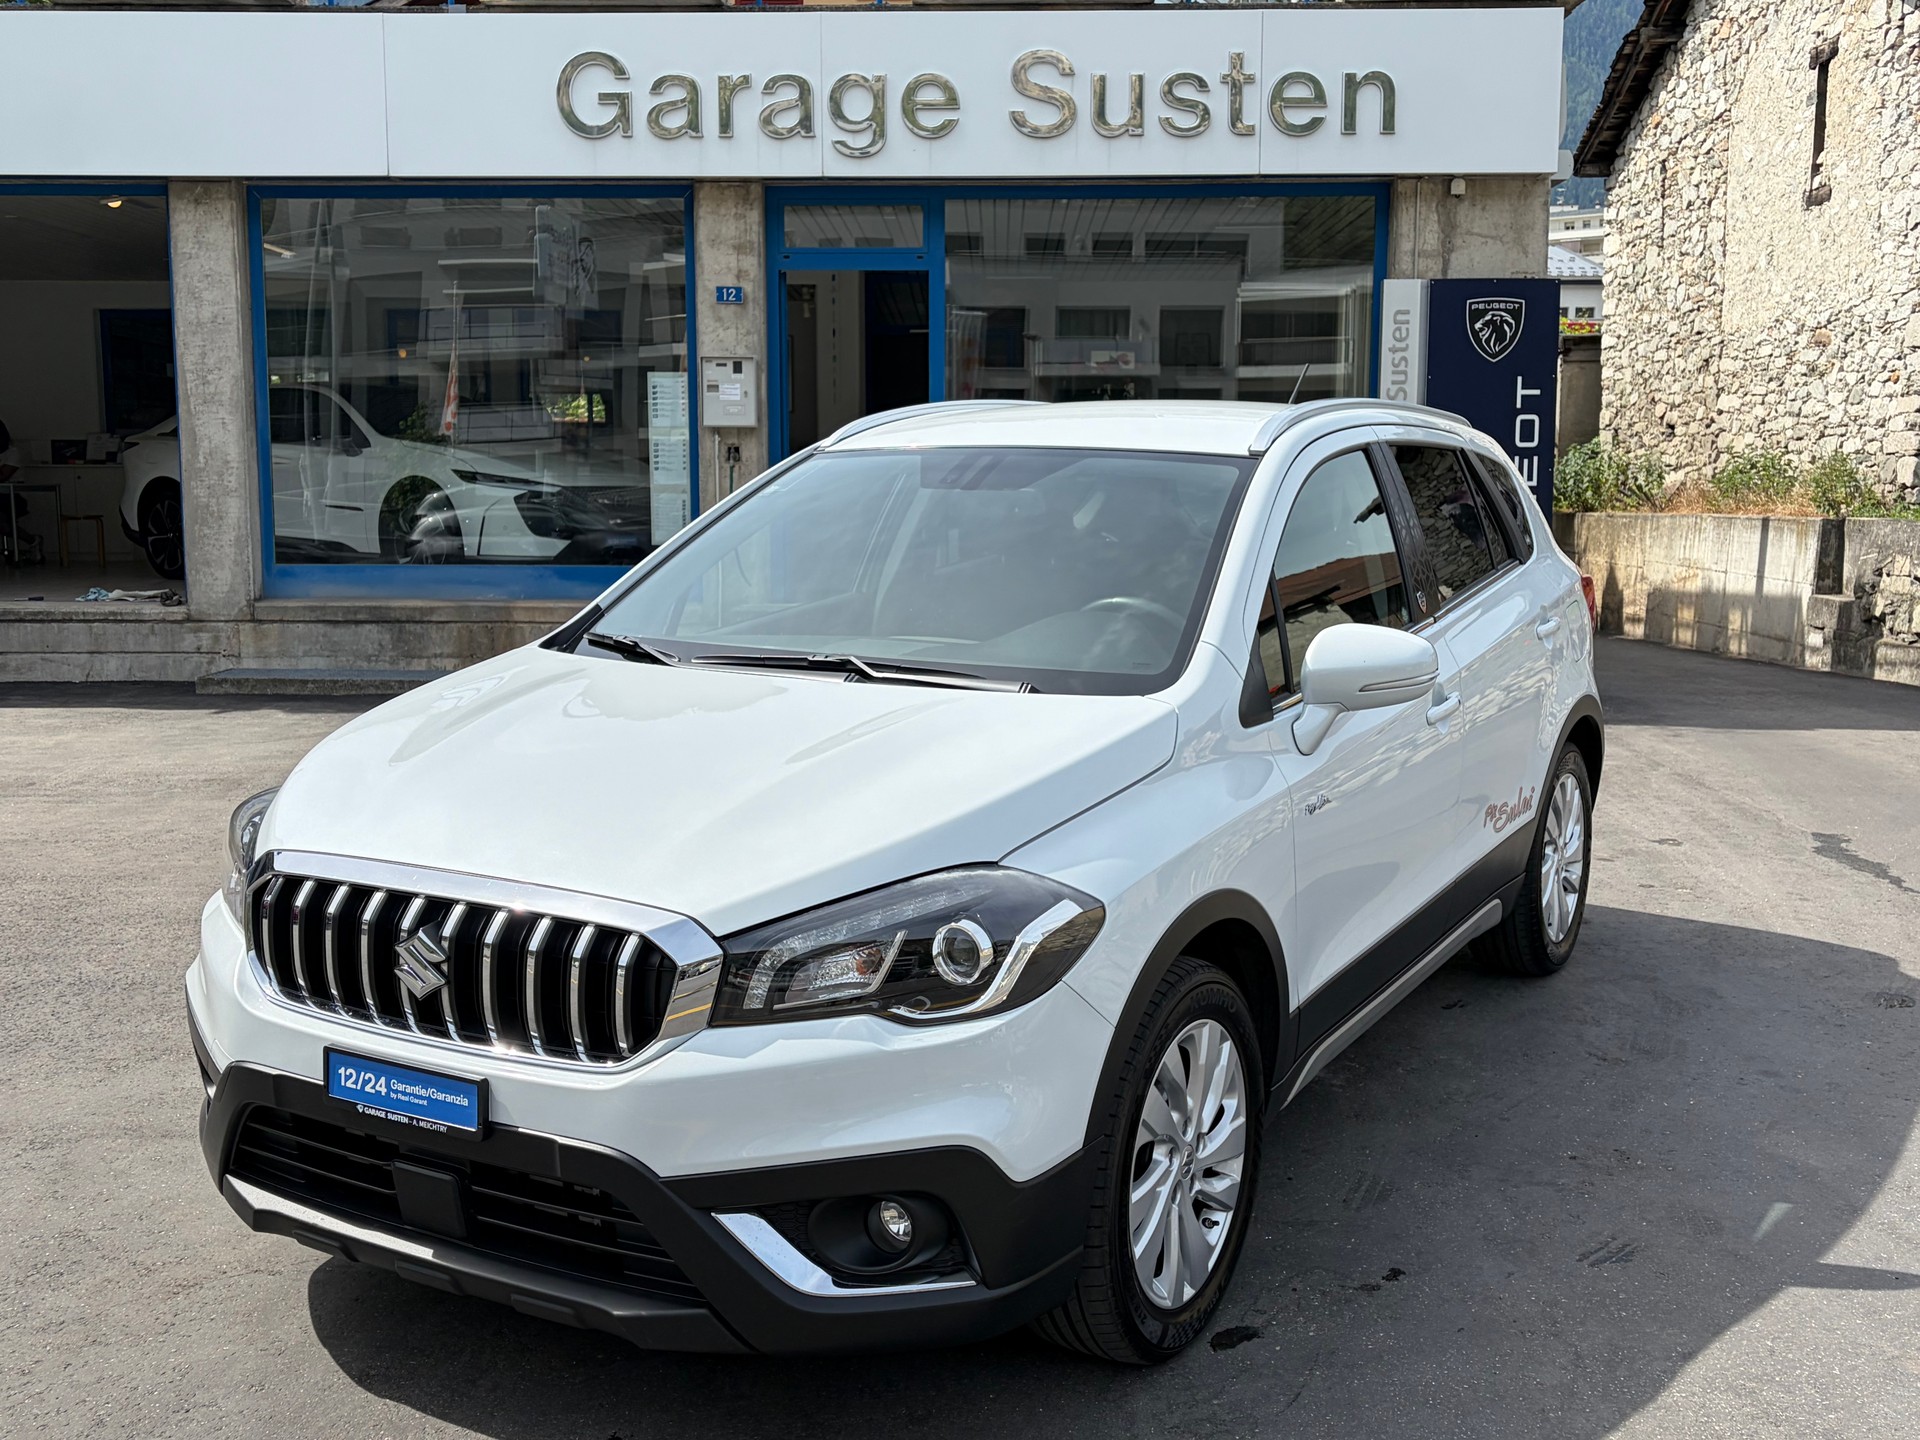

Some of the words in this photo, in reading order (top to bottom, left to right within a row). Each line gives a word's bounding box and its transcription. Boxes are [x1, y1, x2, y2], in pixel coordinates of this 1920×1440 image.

[556, 50, 961, 158] Garage
[1008, 48, 1396, 138] Susten
[722, 288, 736, 301] 12
[1471, 302, 1520, 310] PEUGEOT
[1386, 308, 1411, 402] Susten
[338, 1066, 387, 1096] 12/24
[390, 1079, 469, 1106] Garantie/Garanzia
[390, 1091, 397, 1100] by
[397, 1093, 409, 1103] Real
[409, 1096, 428, 1106] Garant
[364, 1107, 386, 1119] GARAGE
[387, 1112, 408, 1124] SUSTEN
[419, 1122, 447, 1133] MEICHTRY
